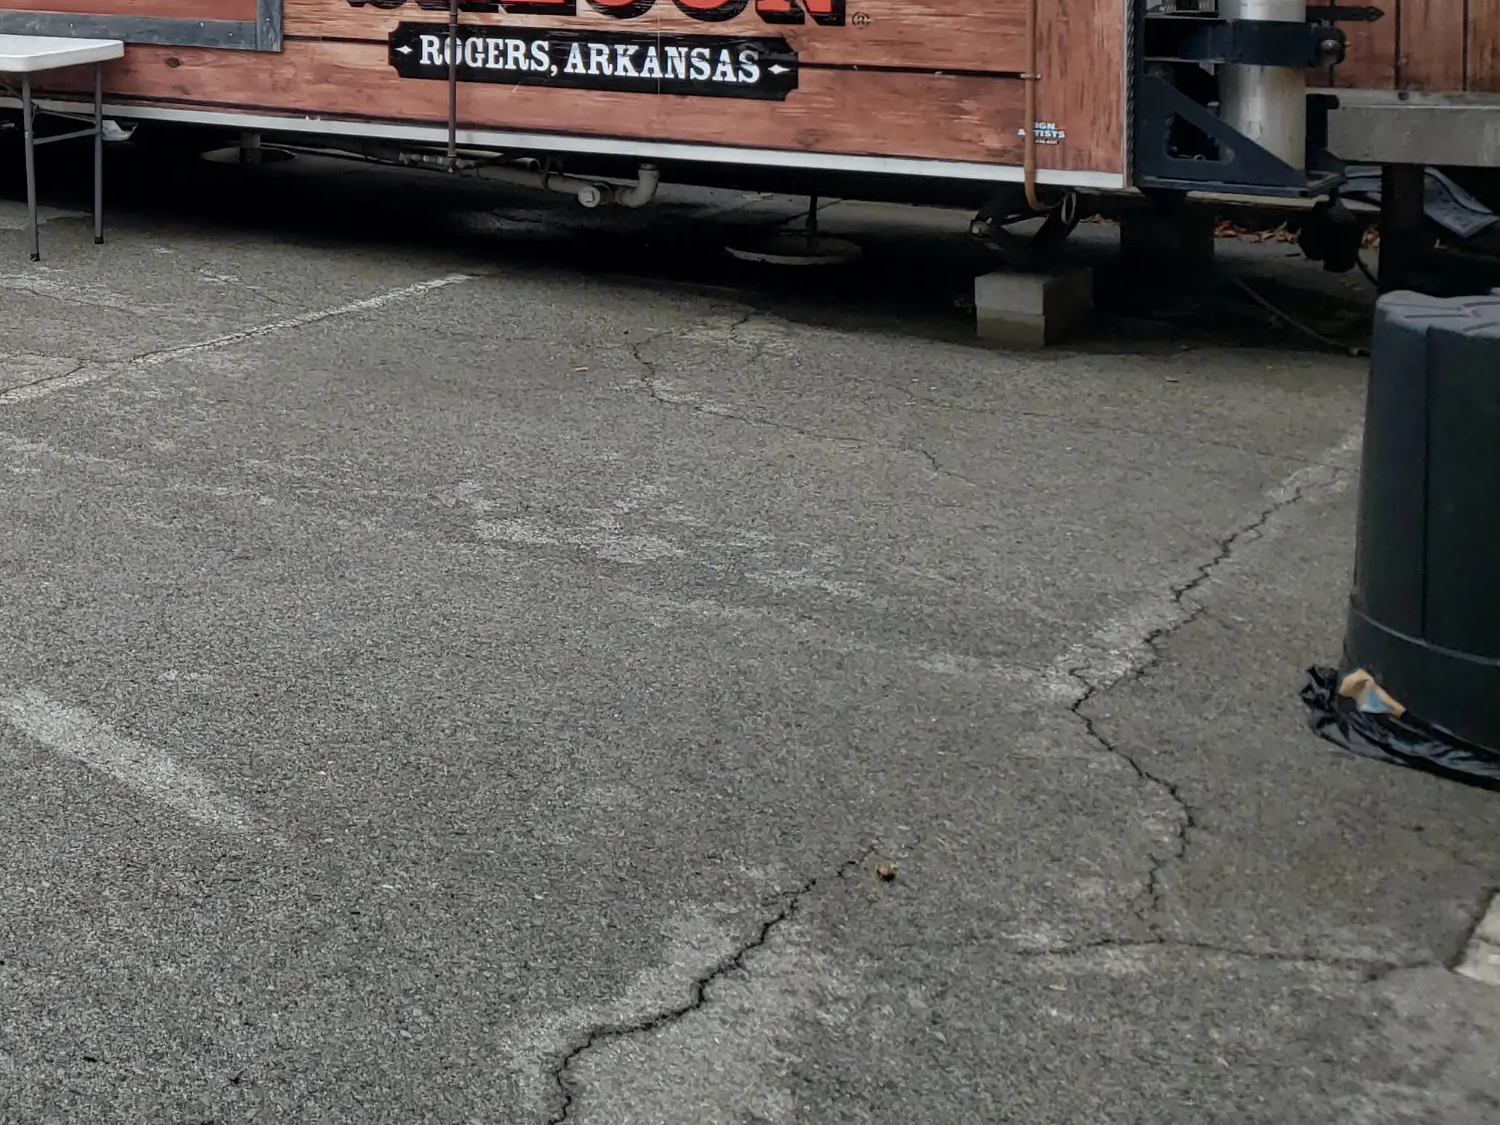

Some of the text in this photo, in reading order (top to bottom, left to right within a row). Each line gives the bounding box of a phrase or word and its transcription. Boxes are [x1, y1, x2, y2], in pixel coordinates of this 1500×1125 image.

[419, 33, 760, 83] ROGERS, ARKANSAS
[1034, 121, 1056, 130] IGN
[1017, 128, 1066, 138] ATISTS
